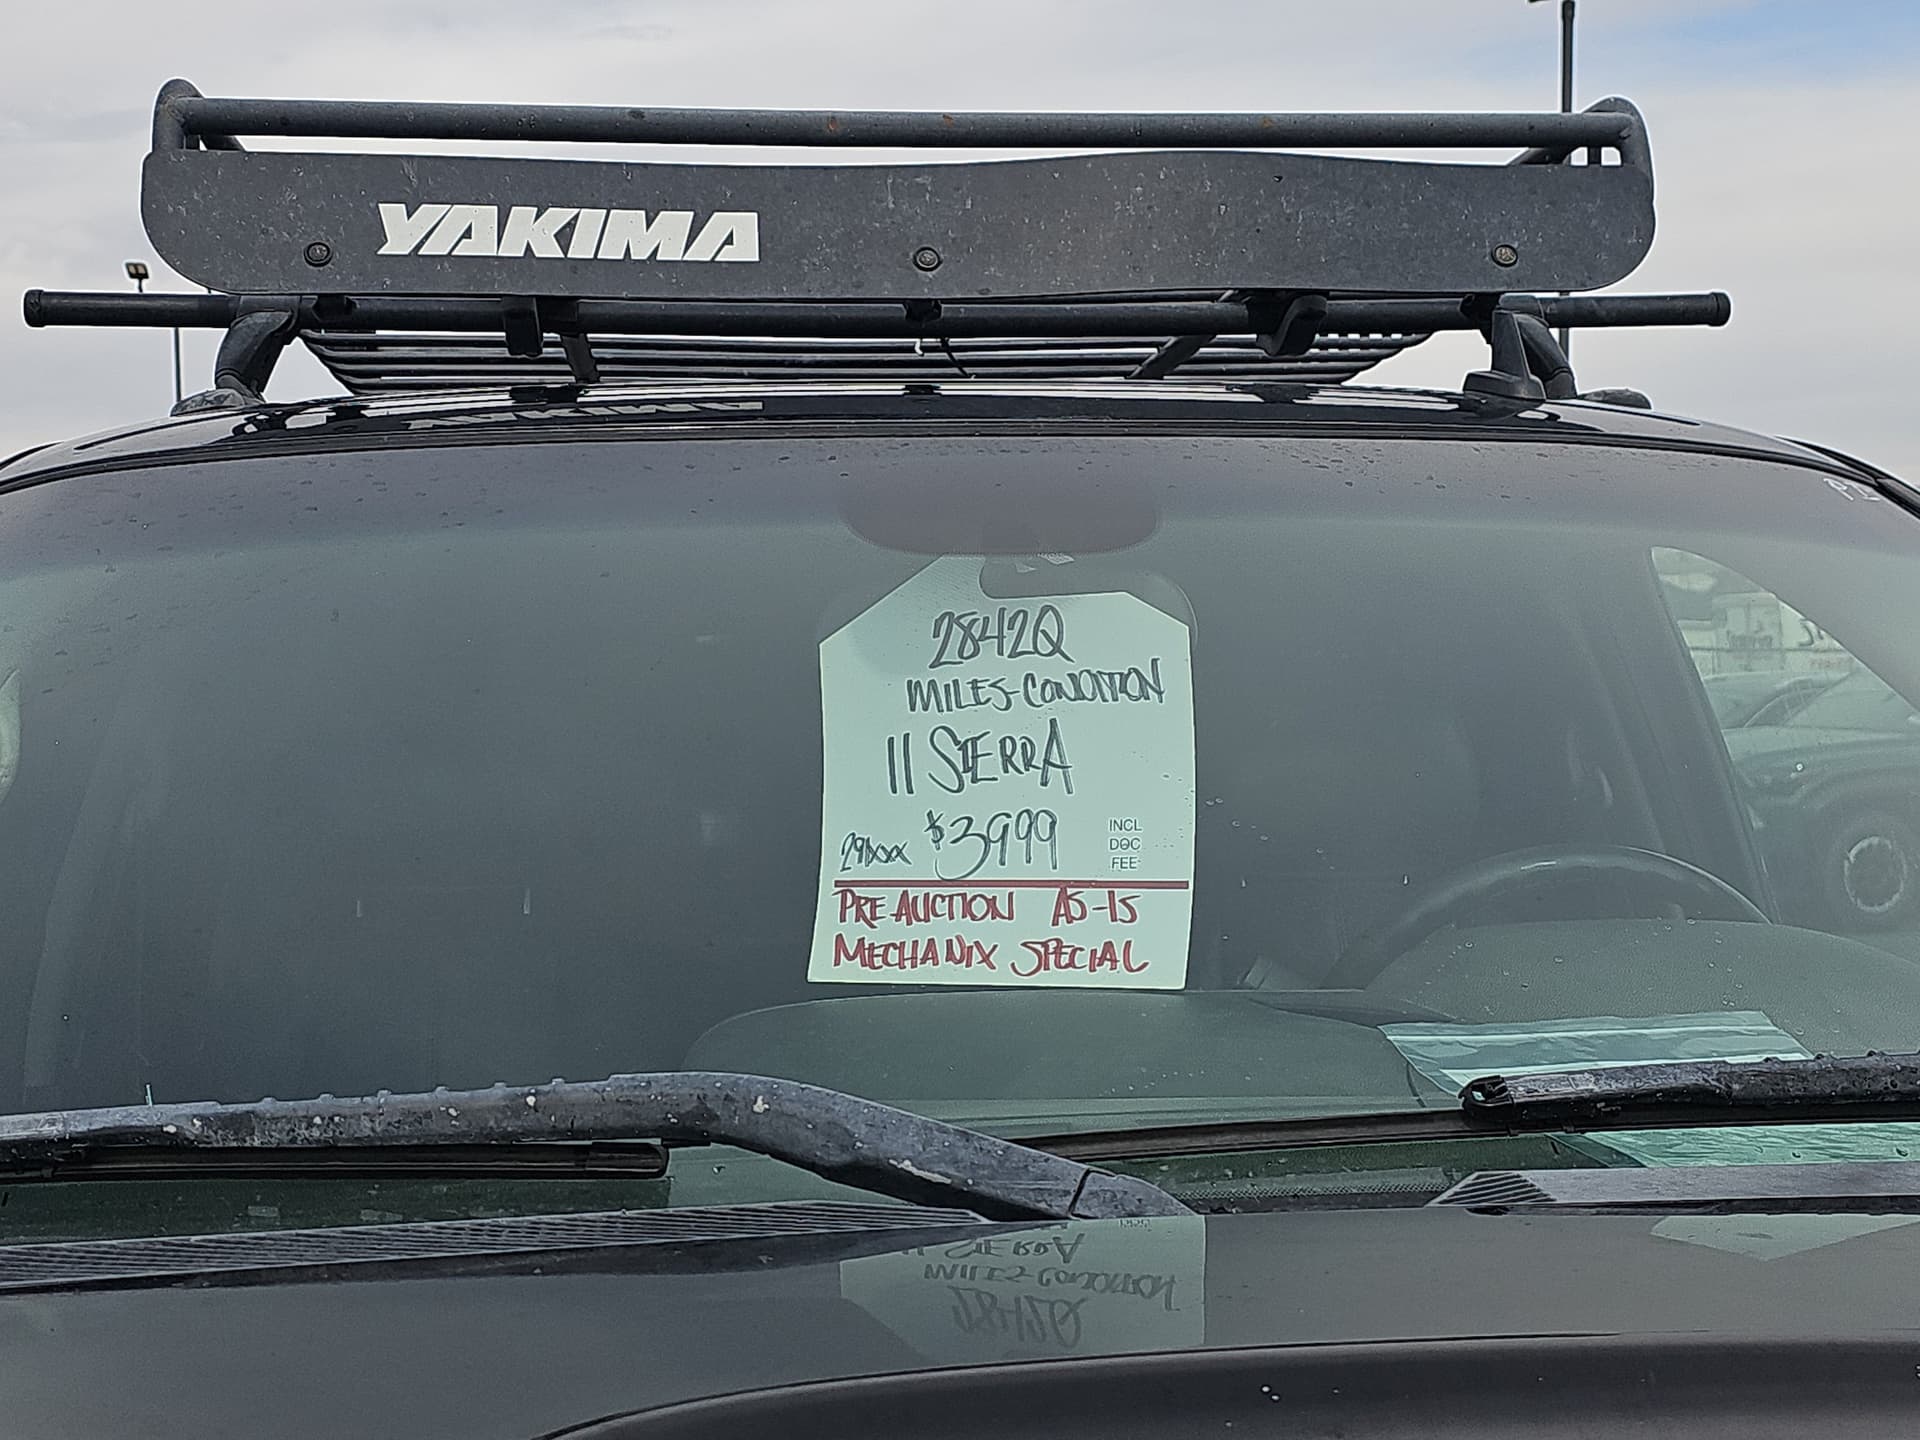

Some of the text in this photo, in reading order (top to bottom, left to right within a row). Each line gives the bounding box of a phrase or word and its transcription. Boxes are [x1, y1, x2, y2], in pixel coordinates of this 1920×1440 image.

[377, 203, 760, 262] YAKIMA
[929, 605, 1075, 668] 2842Q
[928, 718, 1074, 794] SIERRA
[925, 809, 1058, 881] $3999
[1109, 818, 1142, 832] INCL
[1109, 837, 1141, 851] DOC
[1111, 856, 1138, 869] FEE
[1052, 886, 1141, 927] AS-IS
[833, 933, 1149, 977] MECHANIX SPECIAL
